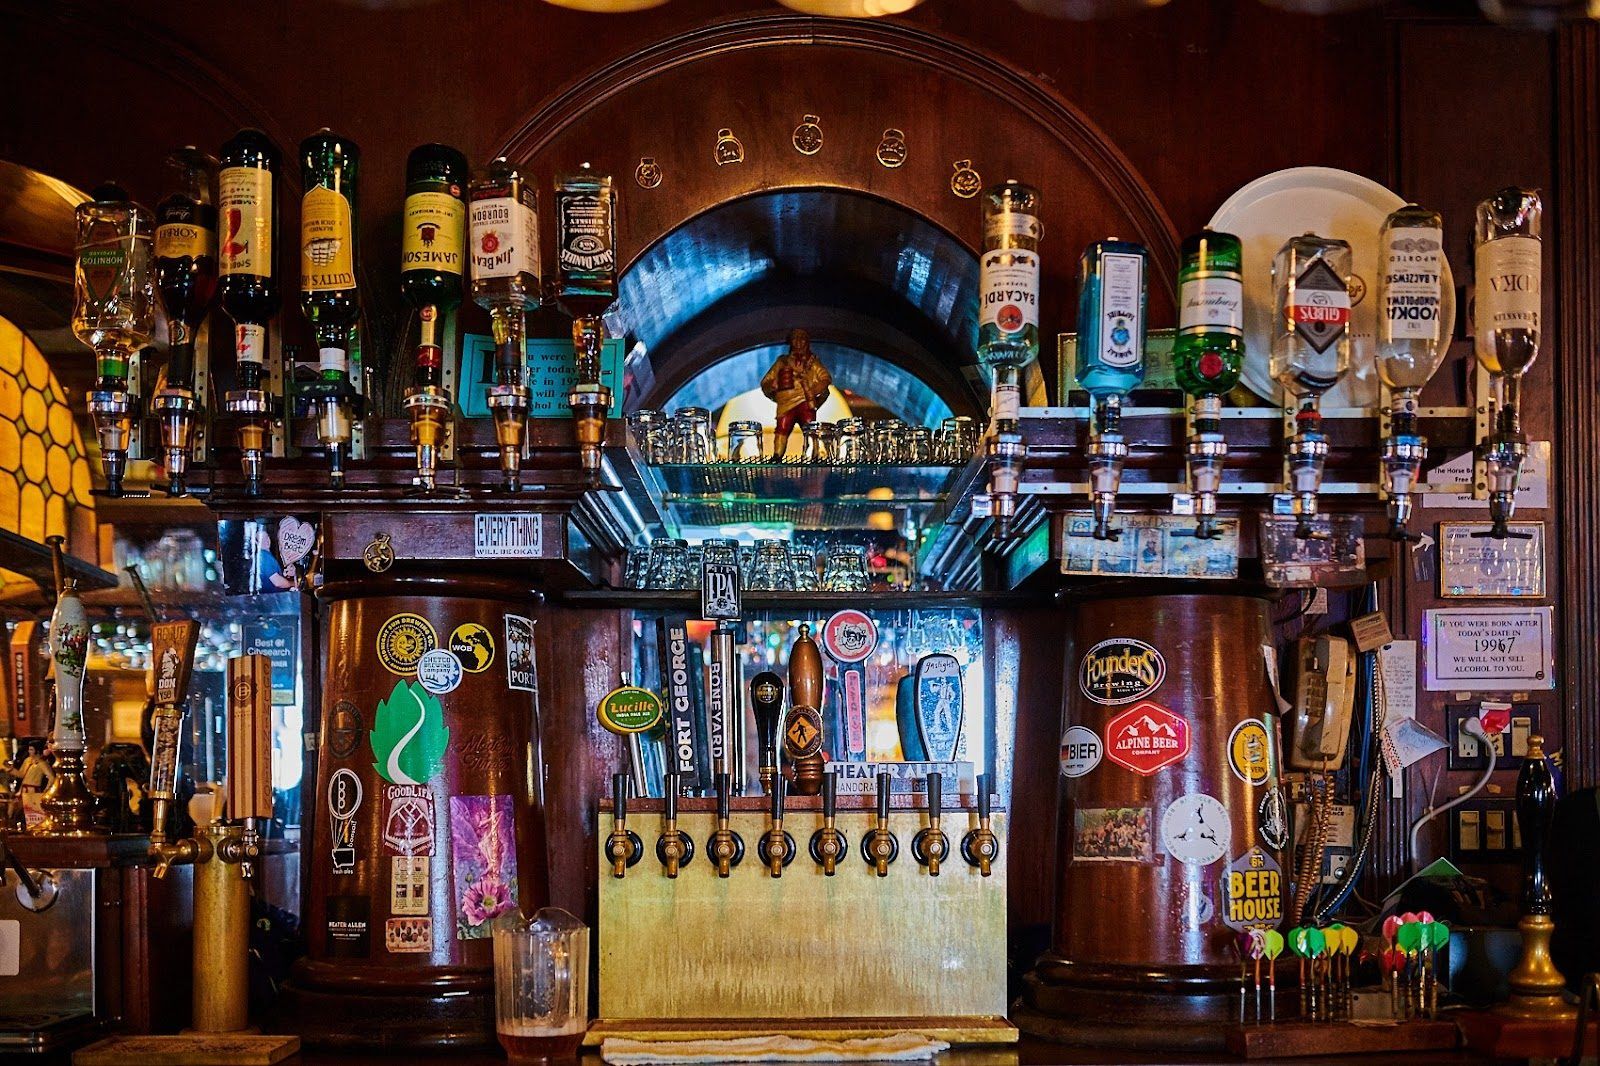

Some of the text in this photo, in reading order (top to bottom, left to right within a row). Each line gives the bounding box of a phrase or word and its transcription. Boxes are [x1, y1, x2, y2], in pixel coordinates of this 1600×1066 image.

[472, 208, 509, 222] BOURBON
[82, 256, 122, 265] HORNITOS
[495, 247, 515, 267] JIM
[592, 248, 614, 267] JACK
[318, 273, 351, 285] CUTTY
[1386, 306, 1441, 321] VODKA
[544, 378, 580, 386] in 197
[536, 390, 556, 398] will
[477, 516, 540, 546] EVERYTHING
[708, 573, 736, 604] IPA
[1439, 620, 1447, 628] IF
[1449, 620, 1466, 628] YOU
[1467, 620, 1489, 628] WERE
[1491, 620, 1513, 628] BORN
[1458, 629, 1490, 638] TODAY'S
[254, 638, 274, 648] Best
[451, 644, 474, 653] WOB
[1509, 655, 1525, 663] SELL
[924, 659, 955, 674] gaslight
[1454, 665, 1526, 673] ALCOHOL TO YOU.
[158, 677, 177, 690] DON
[1093, 680, 1142, 689] Brewing
[670, 628, 694, 772] FORT GEORGE
[610, 701, 655, 714] Lucille
[712, 661, 724, 758] BONEYARD
[1115, 736, 1179, 750] ALPINE BEER
[1069, 743, 1098, 760] BIER
[1229, 870, 1280, 899] BEER
[1229, 898, 1281, 922] HOUSE
